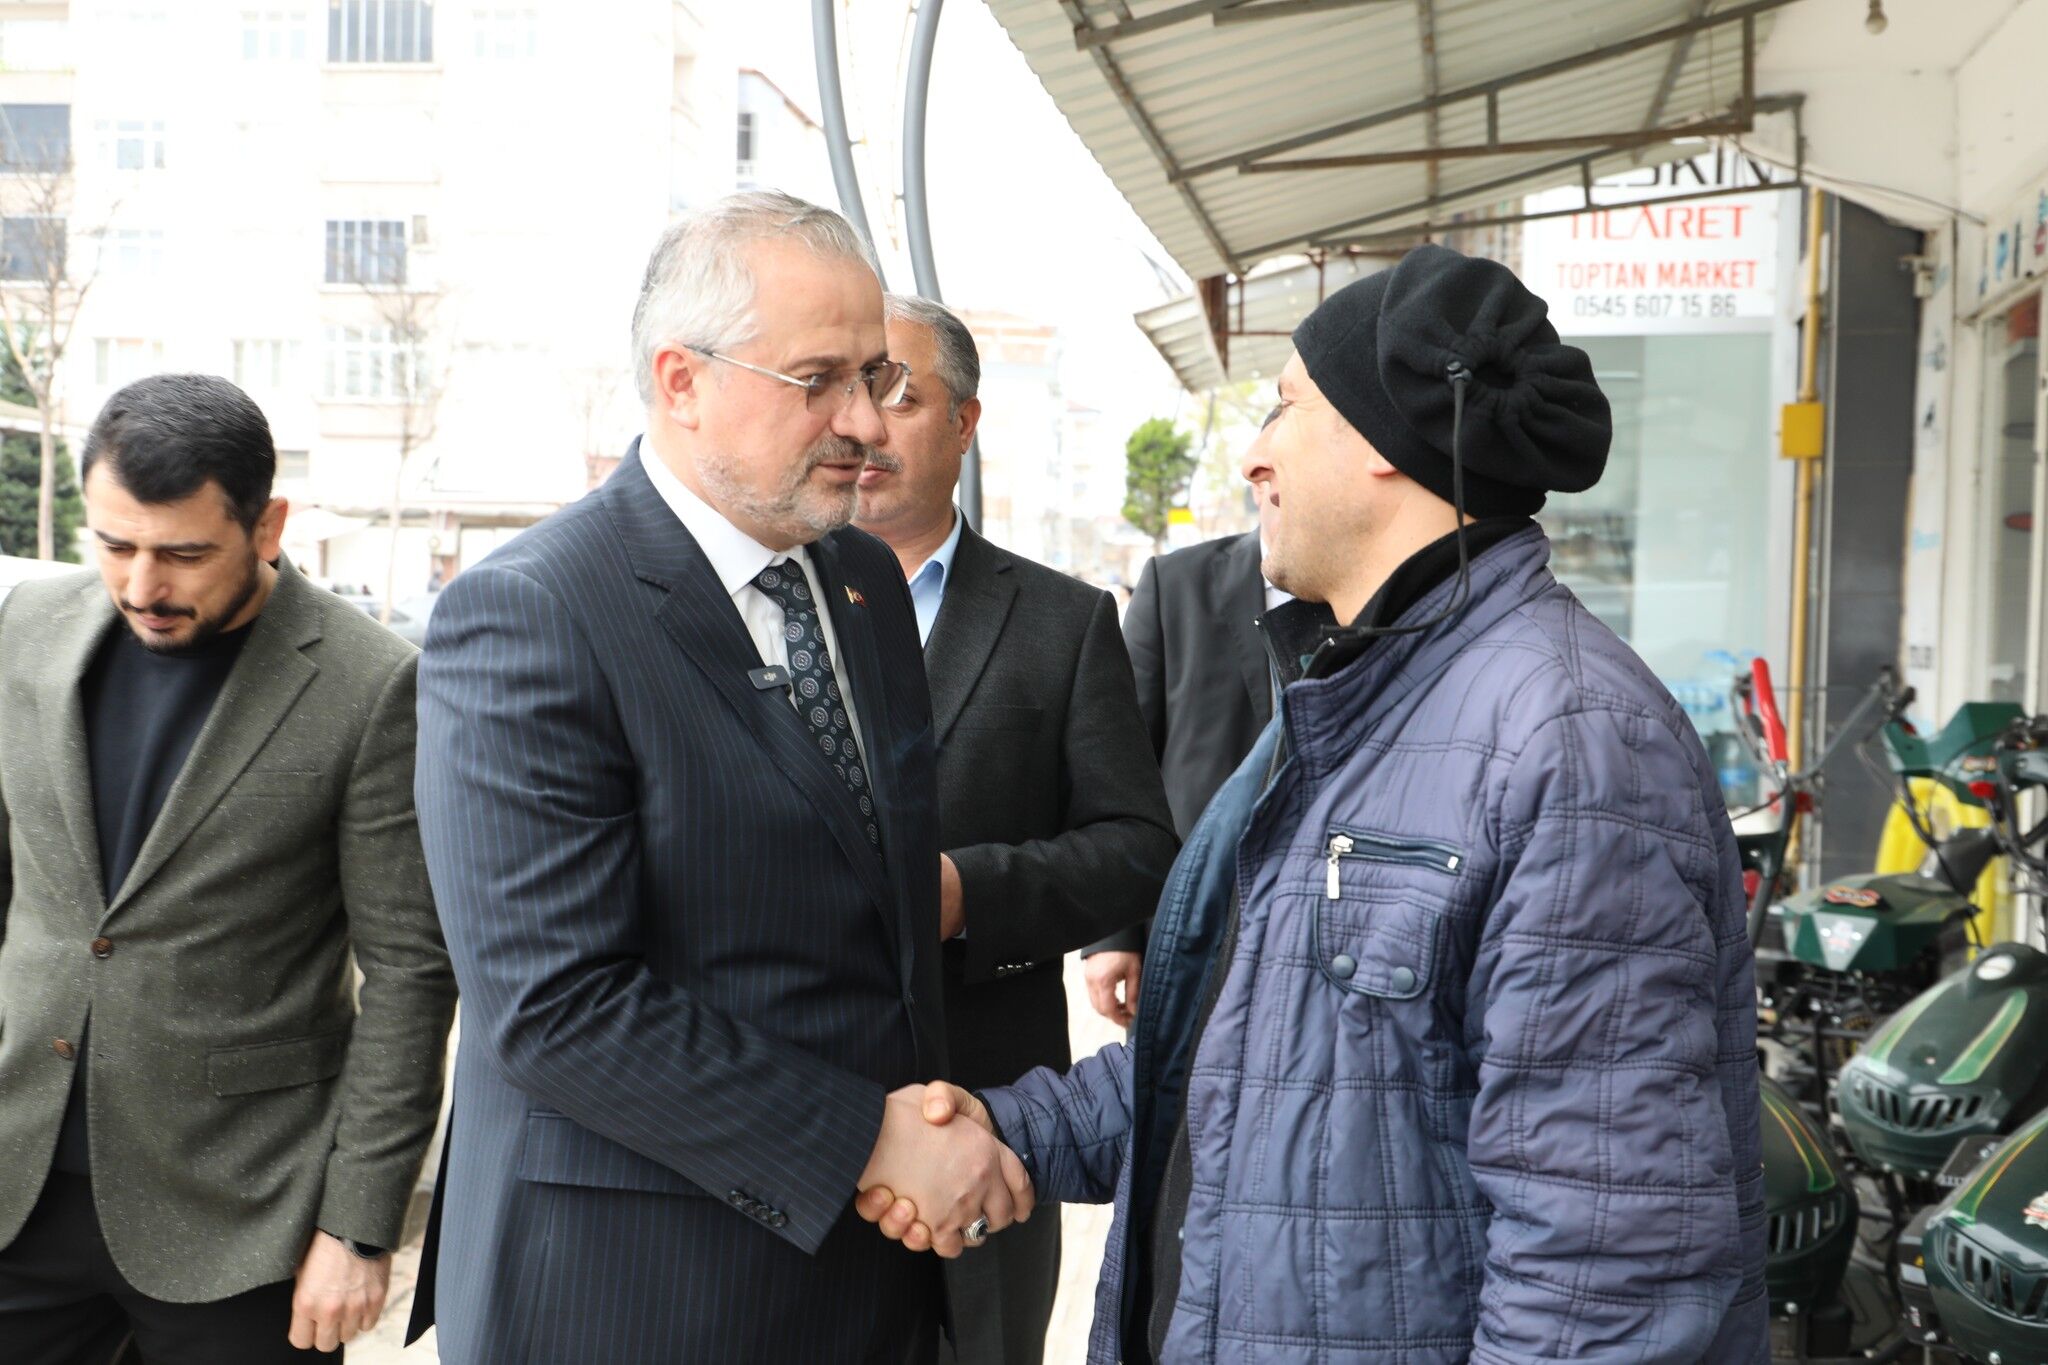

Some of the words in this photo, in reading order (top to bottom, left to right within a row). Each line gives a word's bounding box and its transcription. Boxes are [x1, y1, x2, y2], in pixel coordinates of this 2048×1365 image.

[1557, 262, 1646, 290] TOPTAN
[1656, 259, 1758, 289] MARKET
[1574, 295, 1626, 318] 0545
[1634, 294, 1673, 318] 607
[1681, 294, 1702, 318] 15
[1710, 293, 1737, 318] 86
